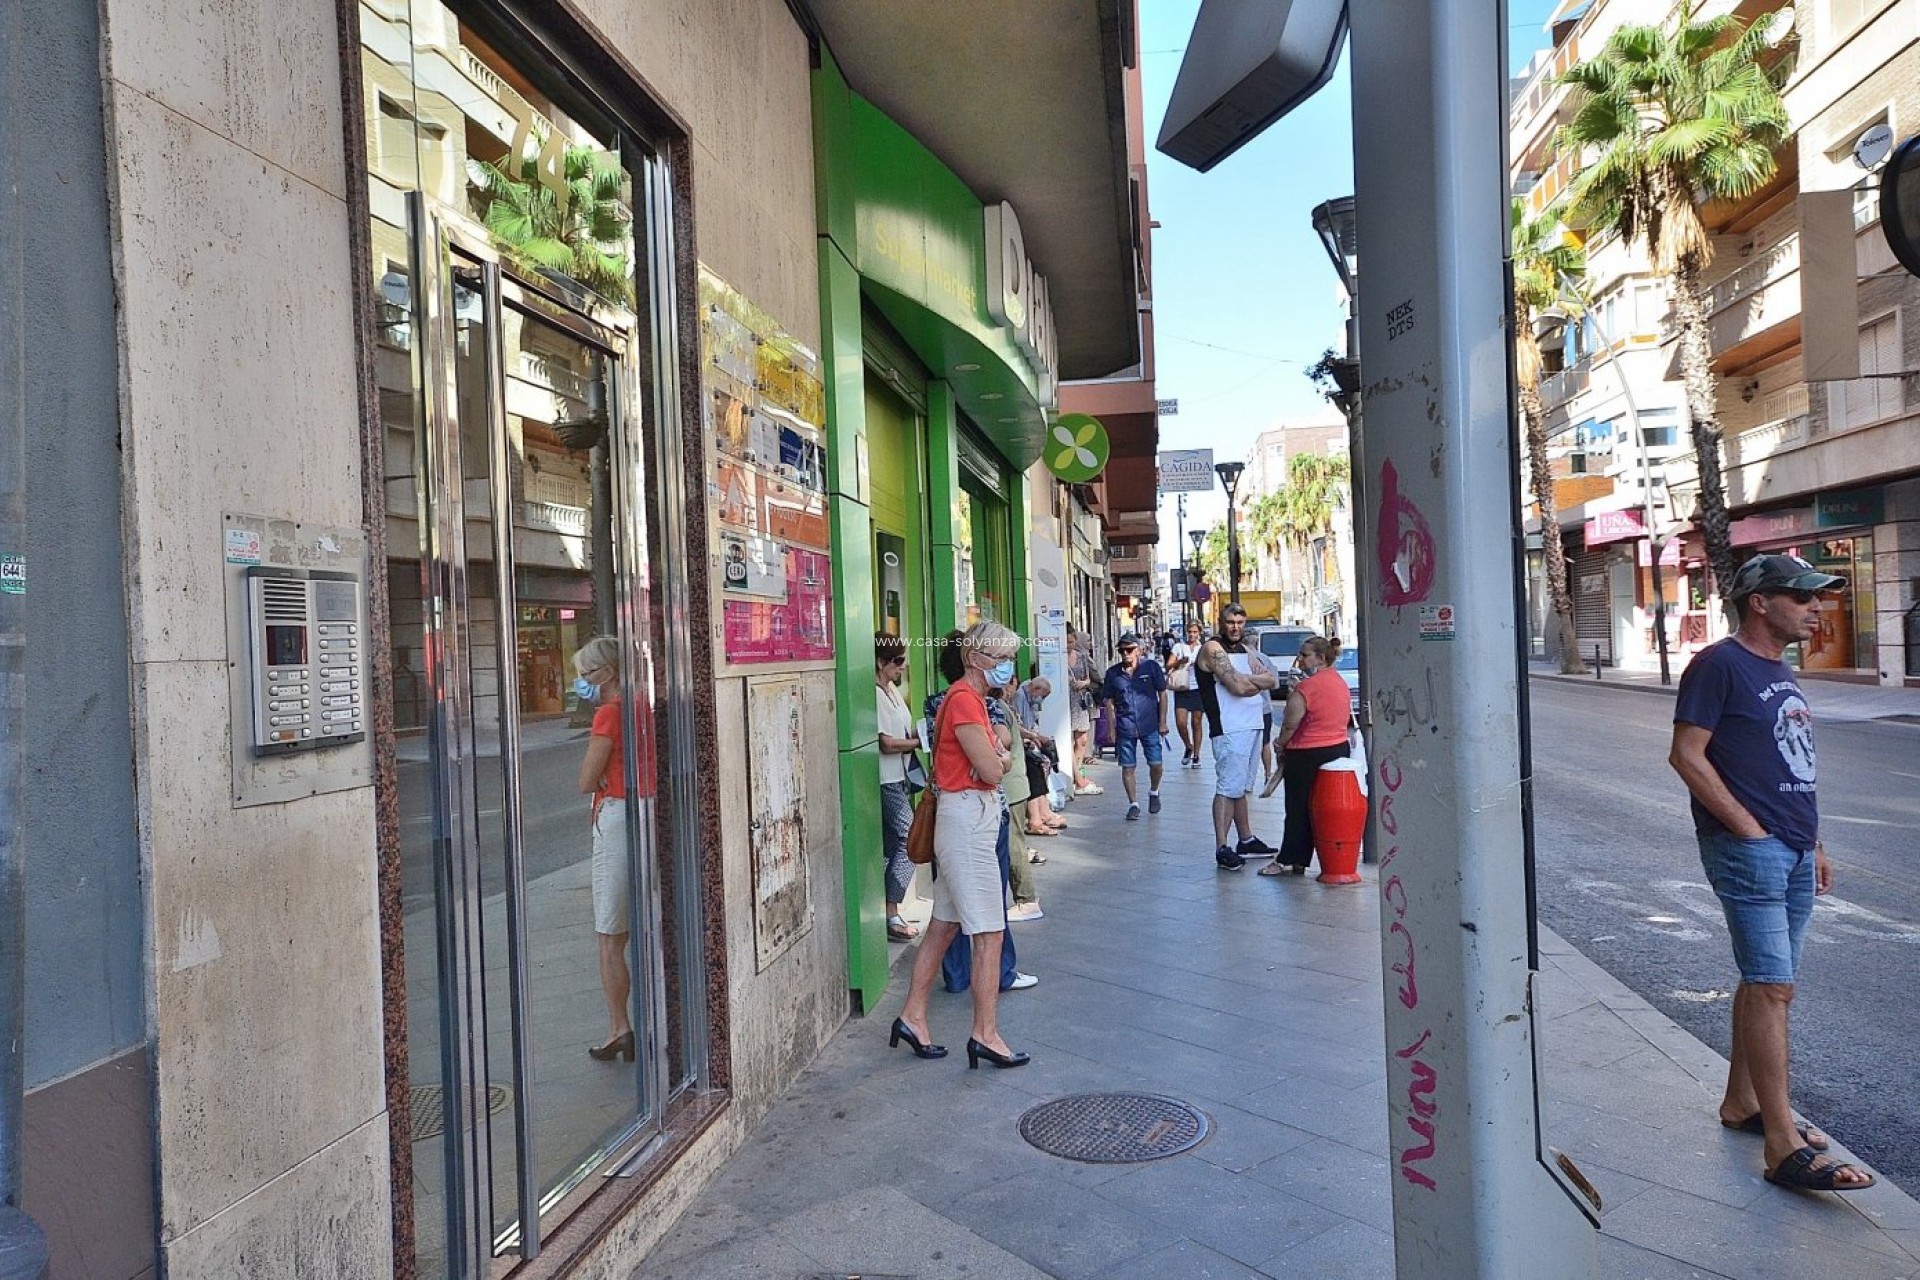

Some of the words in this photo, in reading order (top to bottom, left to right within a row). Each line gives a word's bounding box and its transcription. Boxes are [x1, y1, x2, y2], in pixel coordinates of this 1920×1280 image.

[498, 87, 570, 212] 74
[1386, 299, 1414, 325] NEK
[1388, 315, 1414, 341] DTS
